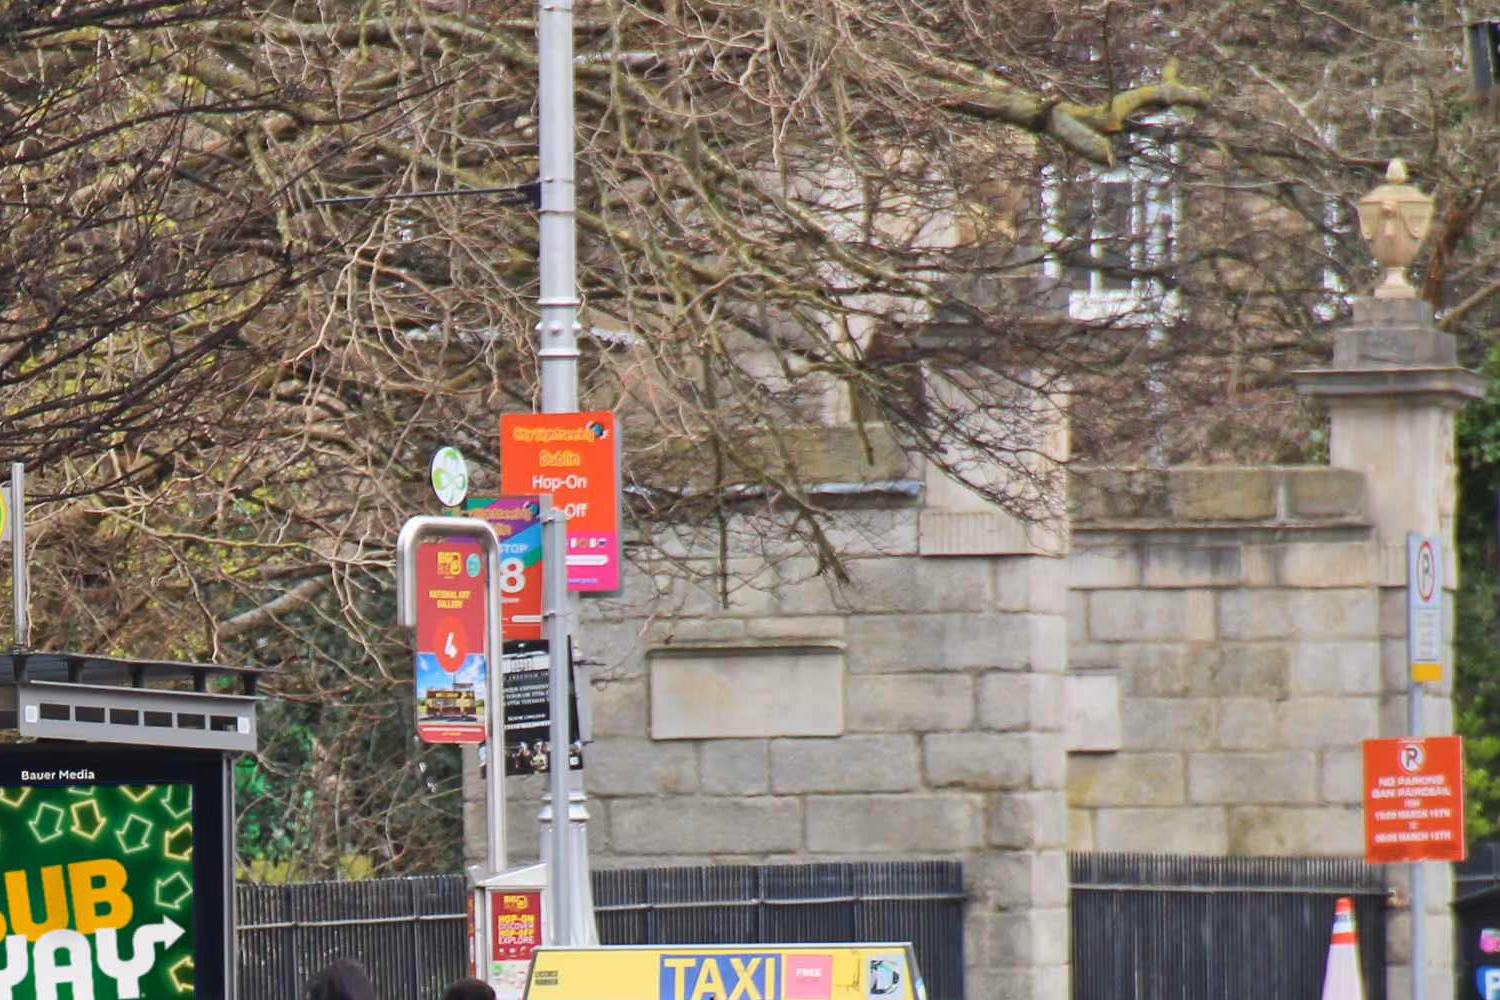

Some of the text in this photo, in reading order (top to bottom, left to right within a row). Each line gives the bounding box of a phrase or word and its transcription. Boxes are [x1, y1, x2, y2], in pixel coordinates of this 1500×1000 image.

[532, 474, 587, 491] Hop-On
[500, 557, 526, 593] 8
[444, 632, 458, 659] 4
[21, 769, 95, 780] Bauer Media
[1378, 774, 1445, 787] NO PARKING
[498, 914, 535, 923] HOP-ON
[497, 922, 535, 930] DISCOVER
[497, 936, 535, 945] EXPLORE
[796, 968, 822, 977] FREE
